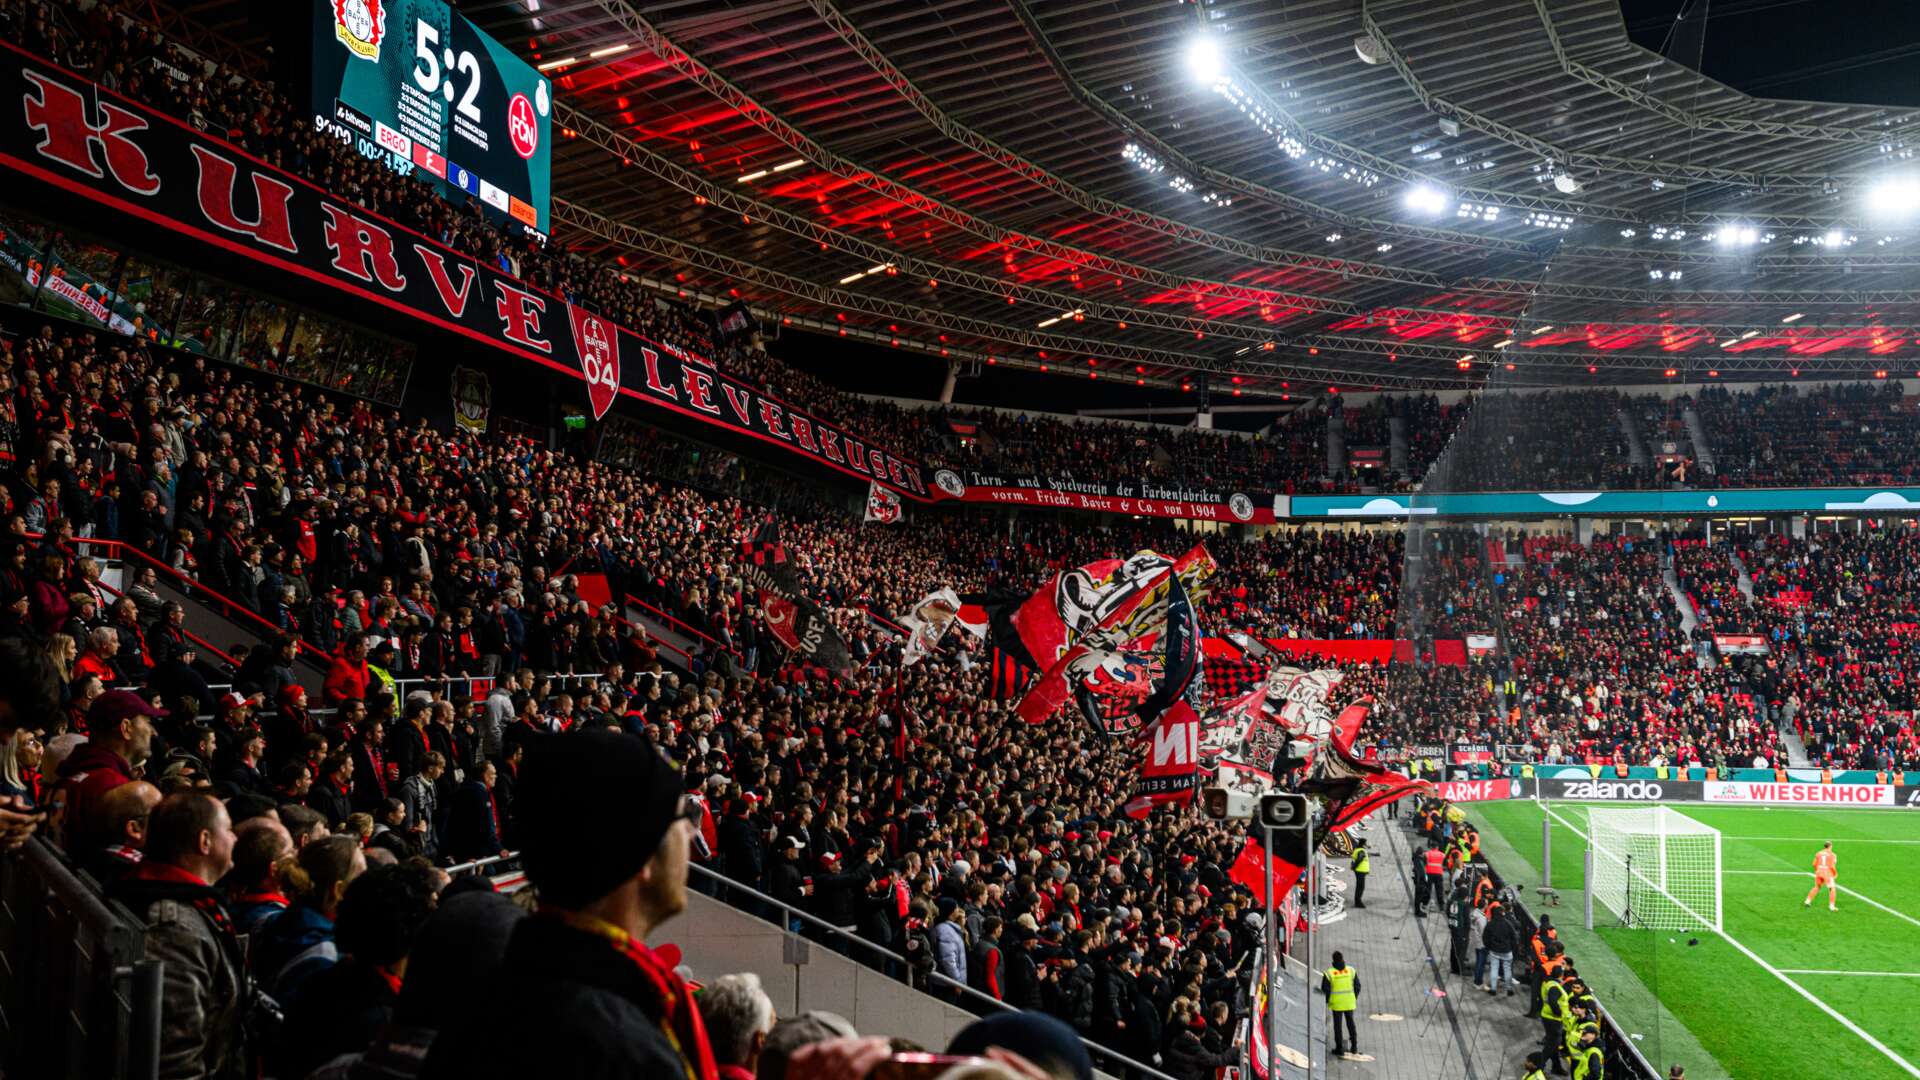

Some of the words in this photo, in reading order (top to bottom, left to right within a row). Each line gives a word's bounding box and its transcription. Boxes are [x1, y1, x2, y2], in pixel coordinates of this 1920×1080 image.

[413, 18, 481, 123] 5:2
[345, 109, 371, 133] bitvavo
[380, 127, 406, 153] ERGO
[22, 68, 553, 355] KURVE
[640, 346, 926, 495] LEVERKUSEN
[584, 353, 617, 391] 04
[971, 471, 1007, 486] Turn-
[1017, 475, 1041, 488] und
[1048, 476, 1107, 495] Spielverein
[1116, 481, 1133, 497] der
[1142, 485, 1221, 504] Farbenfabriken
[991, 491, 1029, 502] vorm.
[1036, 490, 1074, 506] Friedr.
[1137, 500, 1156, 513] Co.
[1164, 505, 1182, 515] von
[1191, 504, 1216, 518] 1904
[1563, 780, 1663, 800] zalando
[1748, 783, 1887, 803] WIESENHOF
